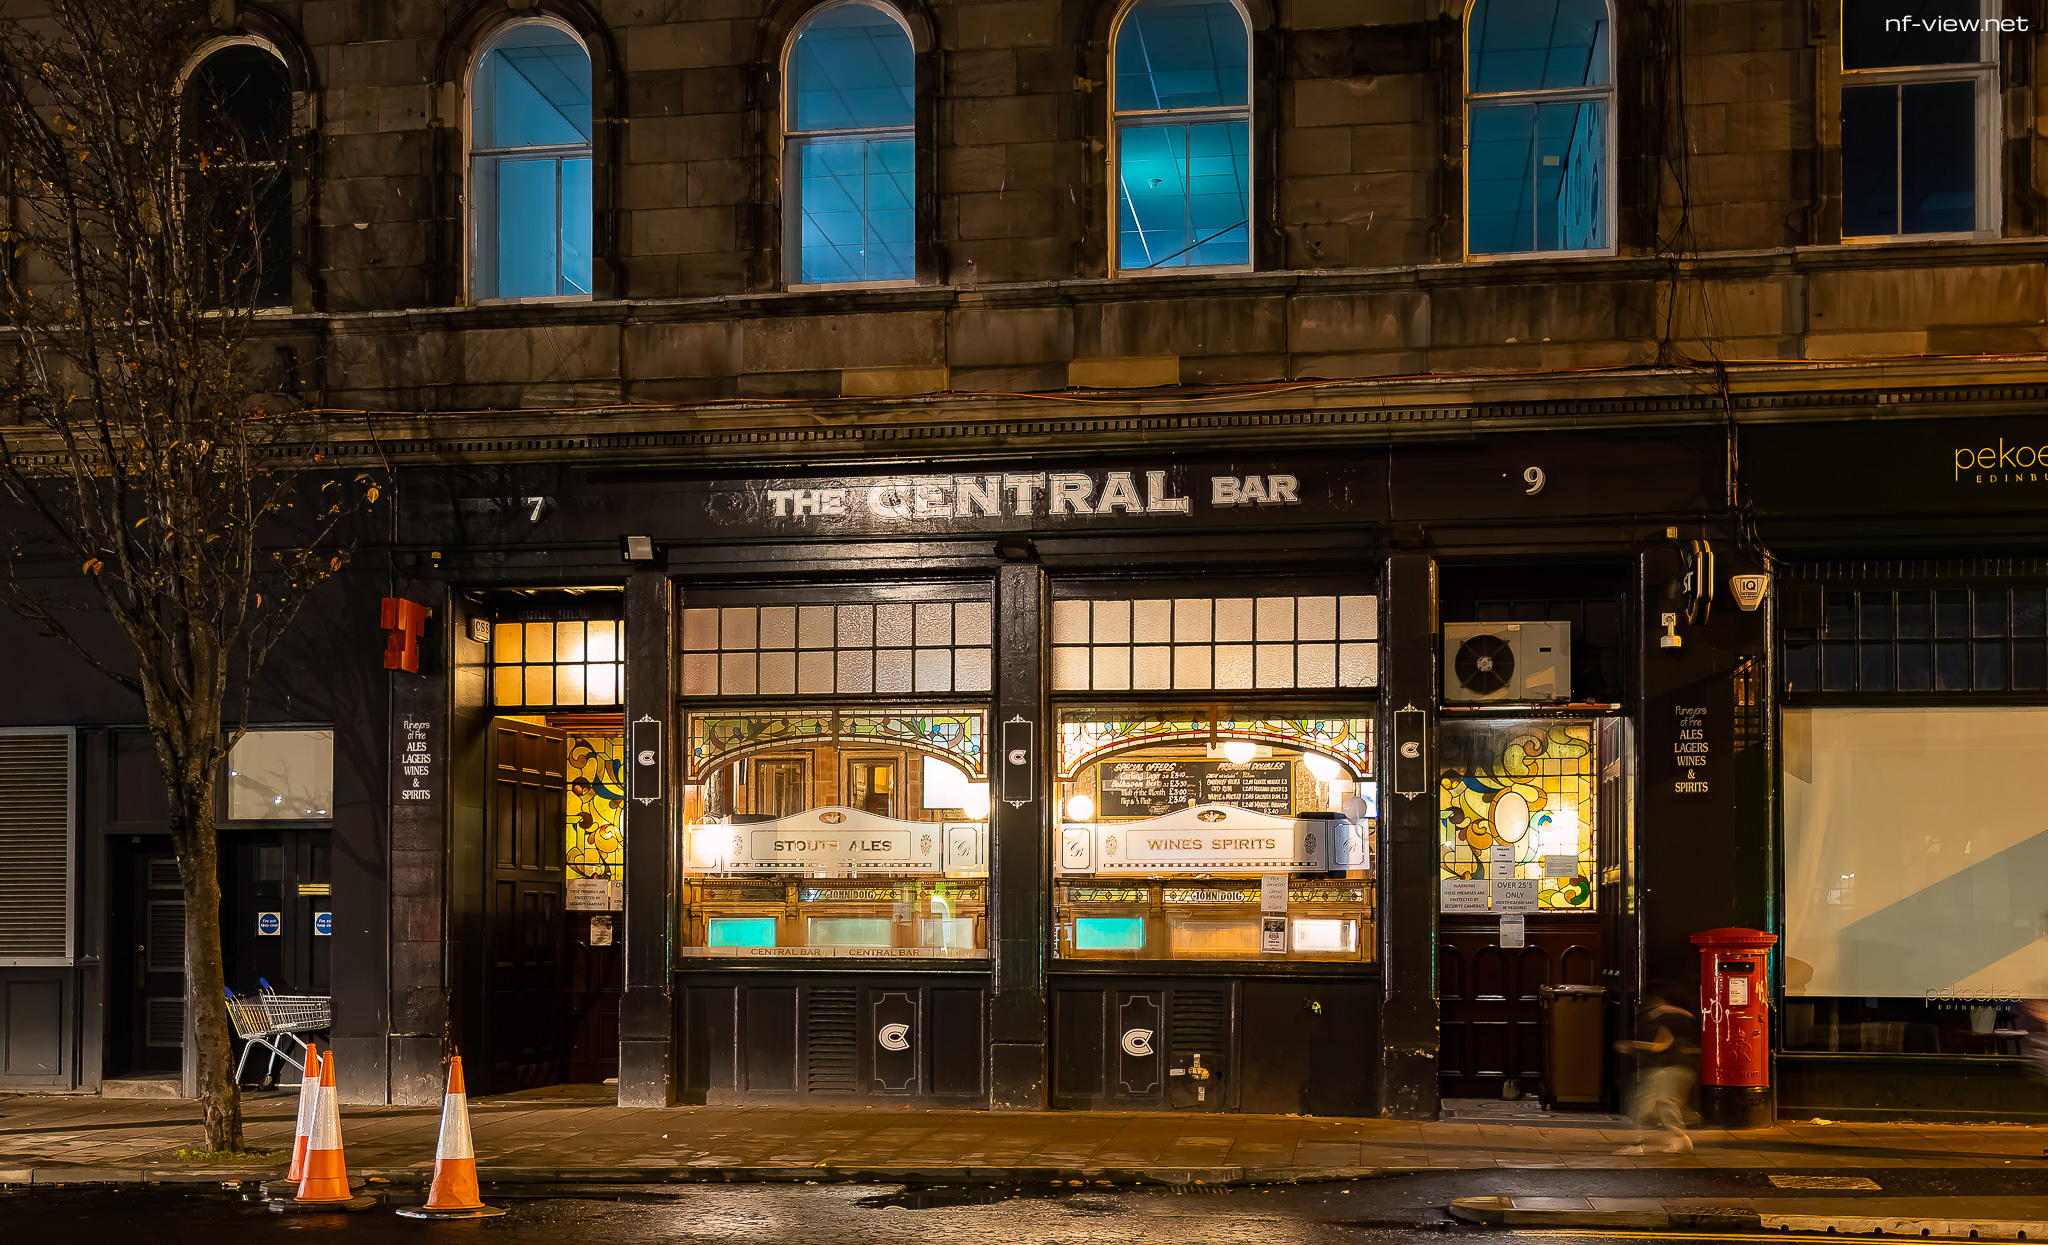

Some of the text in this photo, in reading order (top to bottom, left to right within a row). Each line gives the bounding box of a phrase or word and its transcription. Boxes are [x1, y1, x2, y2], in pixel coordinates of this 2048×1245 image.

[1523, 466, 1544, 493] 9
[767, 471, 1300, 519] THE CENTRAL BAR
[527, 496, 544, 521] 7
[1675, 705, 1707, 719] Purveyors
[403, 720, 431, 730] Purveyors
[1680, 717, 1688, 727] of
[407, 731, 414, 740] of
[1679, 729, 1703, 740] ALES
[406, 741, 427, 752] ALES
[1674, 742, 1709, 753] LAGERS
[401, 753, 431, 764] LAGERS
[1677, 755, 1706, 767] WINES
[404, 765, 429, 776] WINES
[1113, 762, 1176, 772] SPECIAL OFFERS
[1217, 762, 1286, 771] PREMIUM DOUBLES
[1120, 771, 1143, 780] Carling
[1146, 771, 1161, 780] Lager
[1687, 768, 1696, 779] &
[412, 777, 420, 788] &
[1111, 780, 1143, 788] Belhaven
[1145, 780, 1160, 788] Best
[1675, 781, 1709, 793] SPIRITS
[401, 789, 431, 800] SPIRITS
[848, 840, 893, 852] ALES
[1146, 838, 1276, 851] WINES SPIRITS
[1496, 881, 1533, 889] OVER 25'S
[852, 890, 875, 899] DOIG
[1220, 890, 1243, 900] DOIG
[1505, 891, 1525, 899] ONLY
[750, 948, 822, 956] CENTRAL BAR
[849, 948, 896, 956] CENTRAL
[898, 948, 920, 957] BAR
